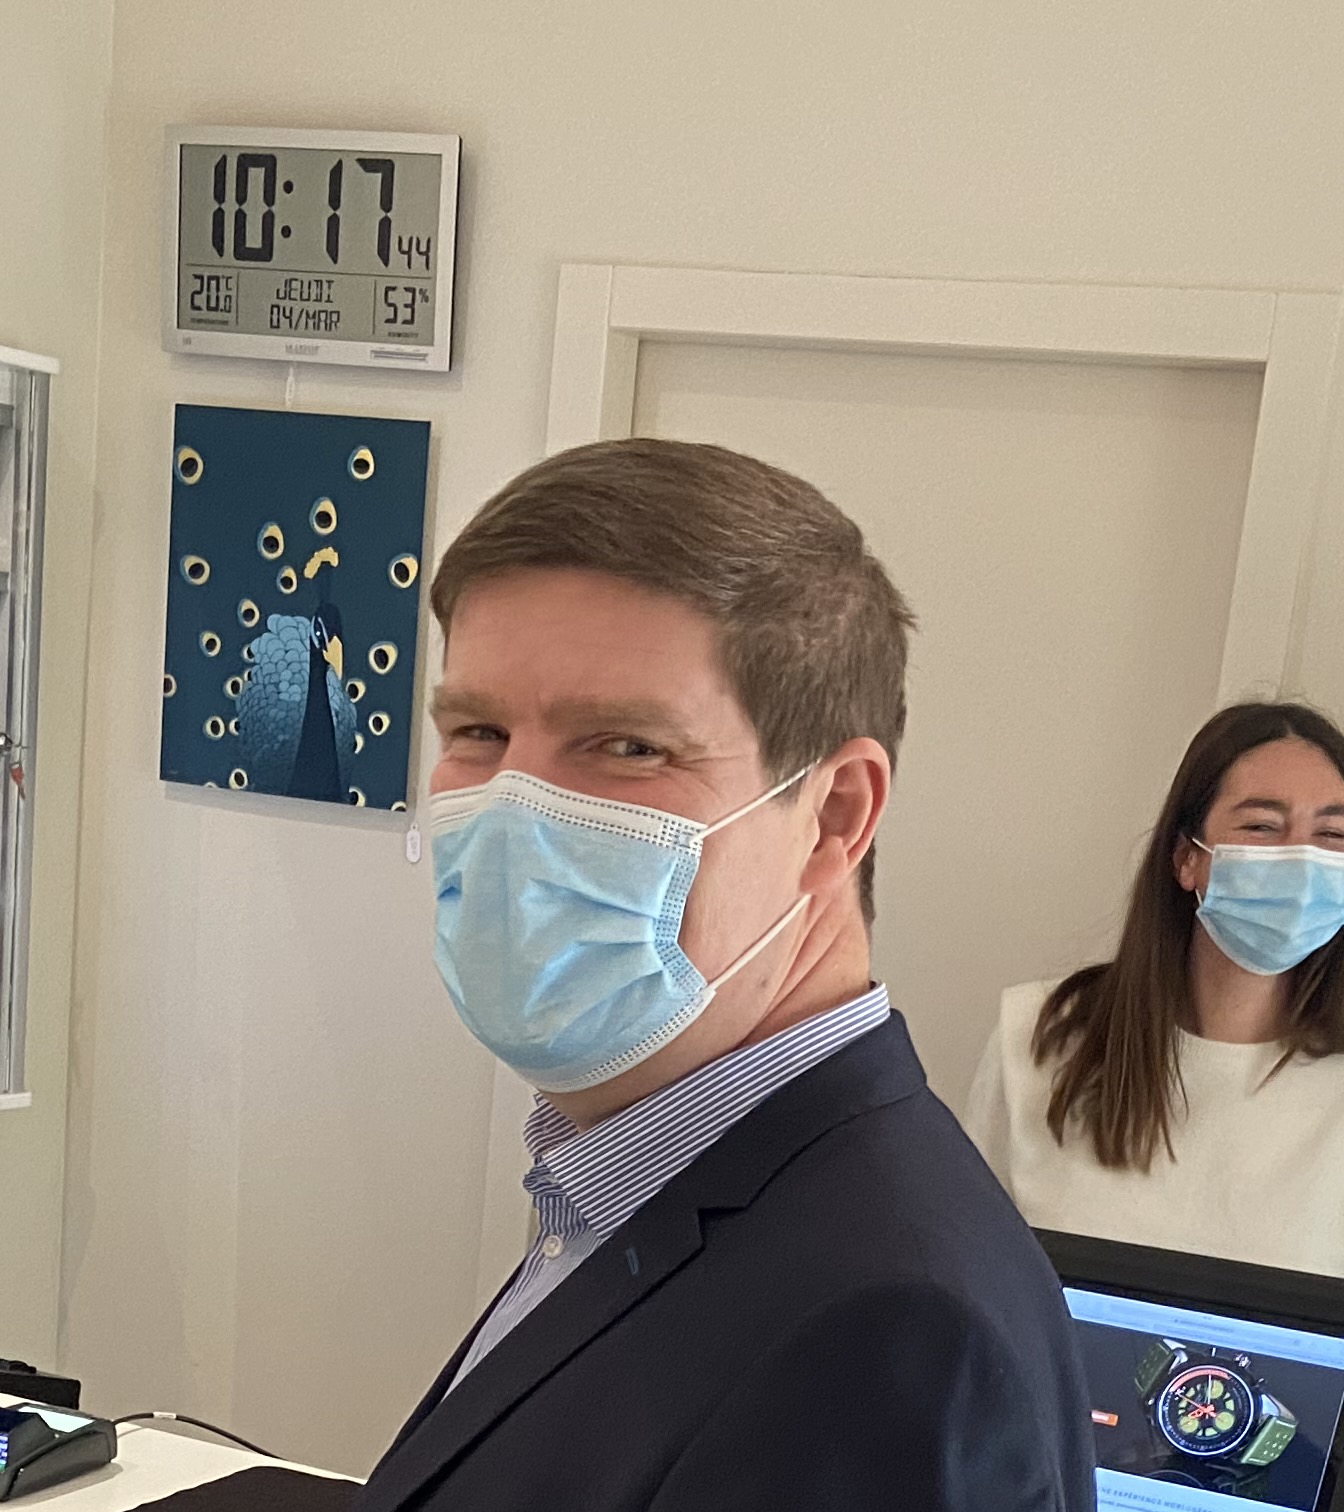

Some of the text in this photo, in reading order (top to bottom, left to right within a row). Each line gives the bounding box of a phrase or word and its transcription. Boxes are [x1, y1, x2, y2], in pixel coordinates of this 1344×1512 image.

[212, 153, 431, 271] 10:17 44
[276, 277, 335, 303] JEUDI
[269, 303, 341, 332] 04/MAR
